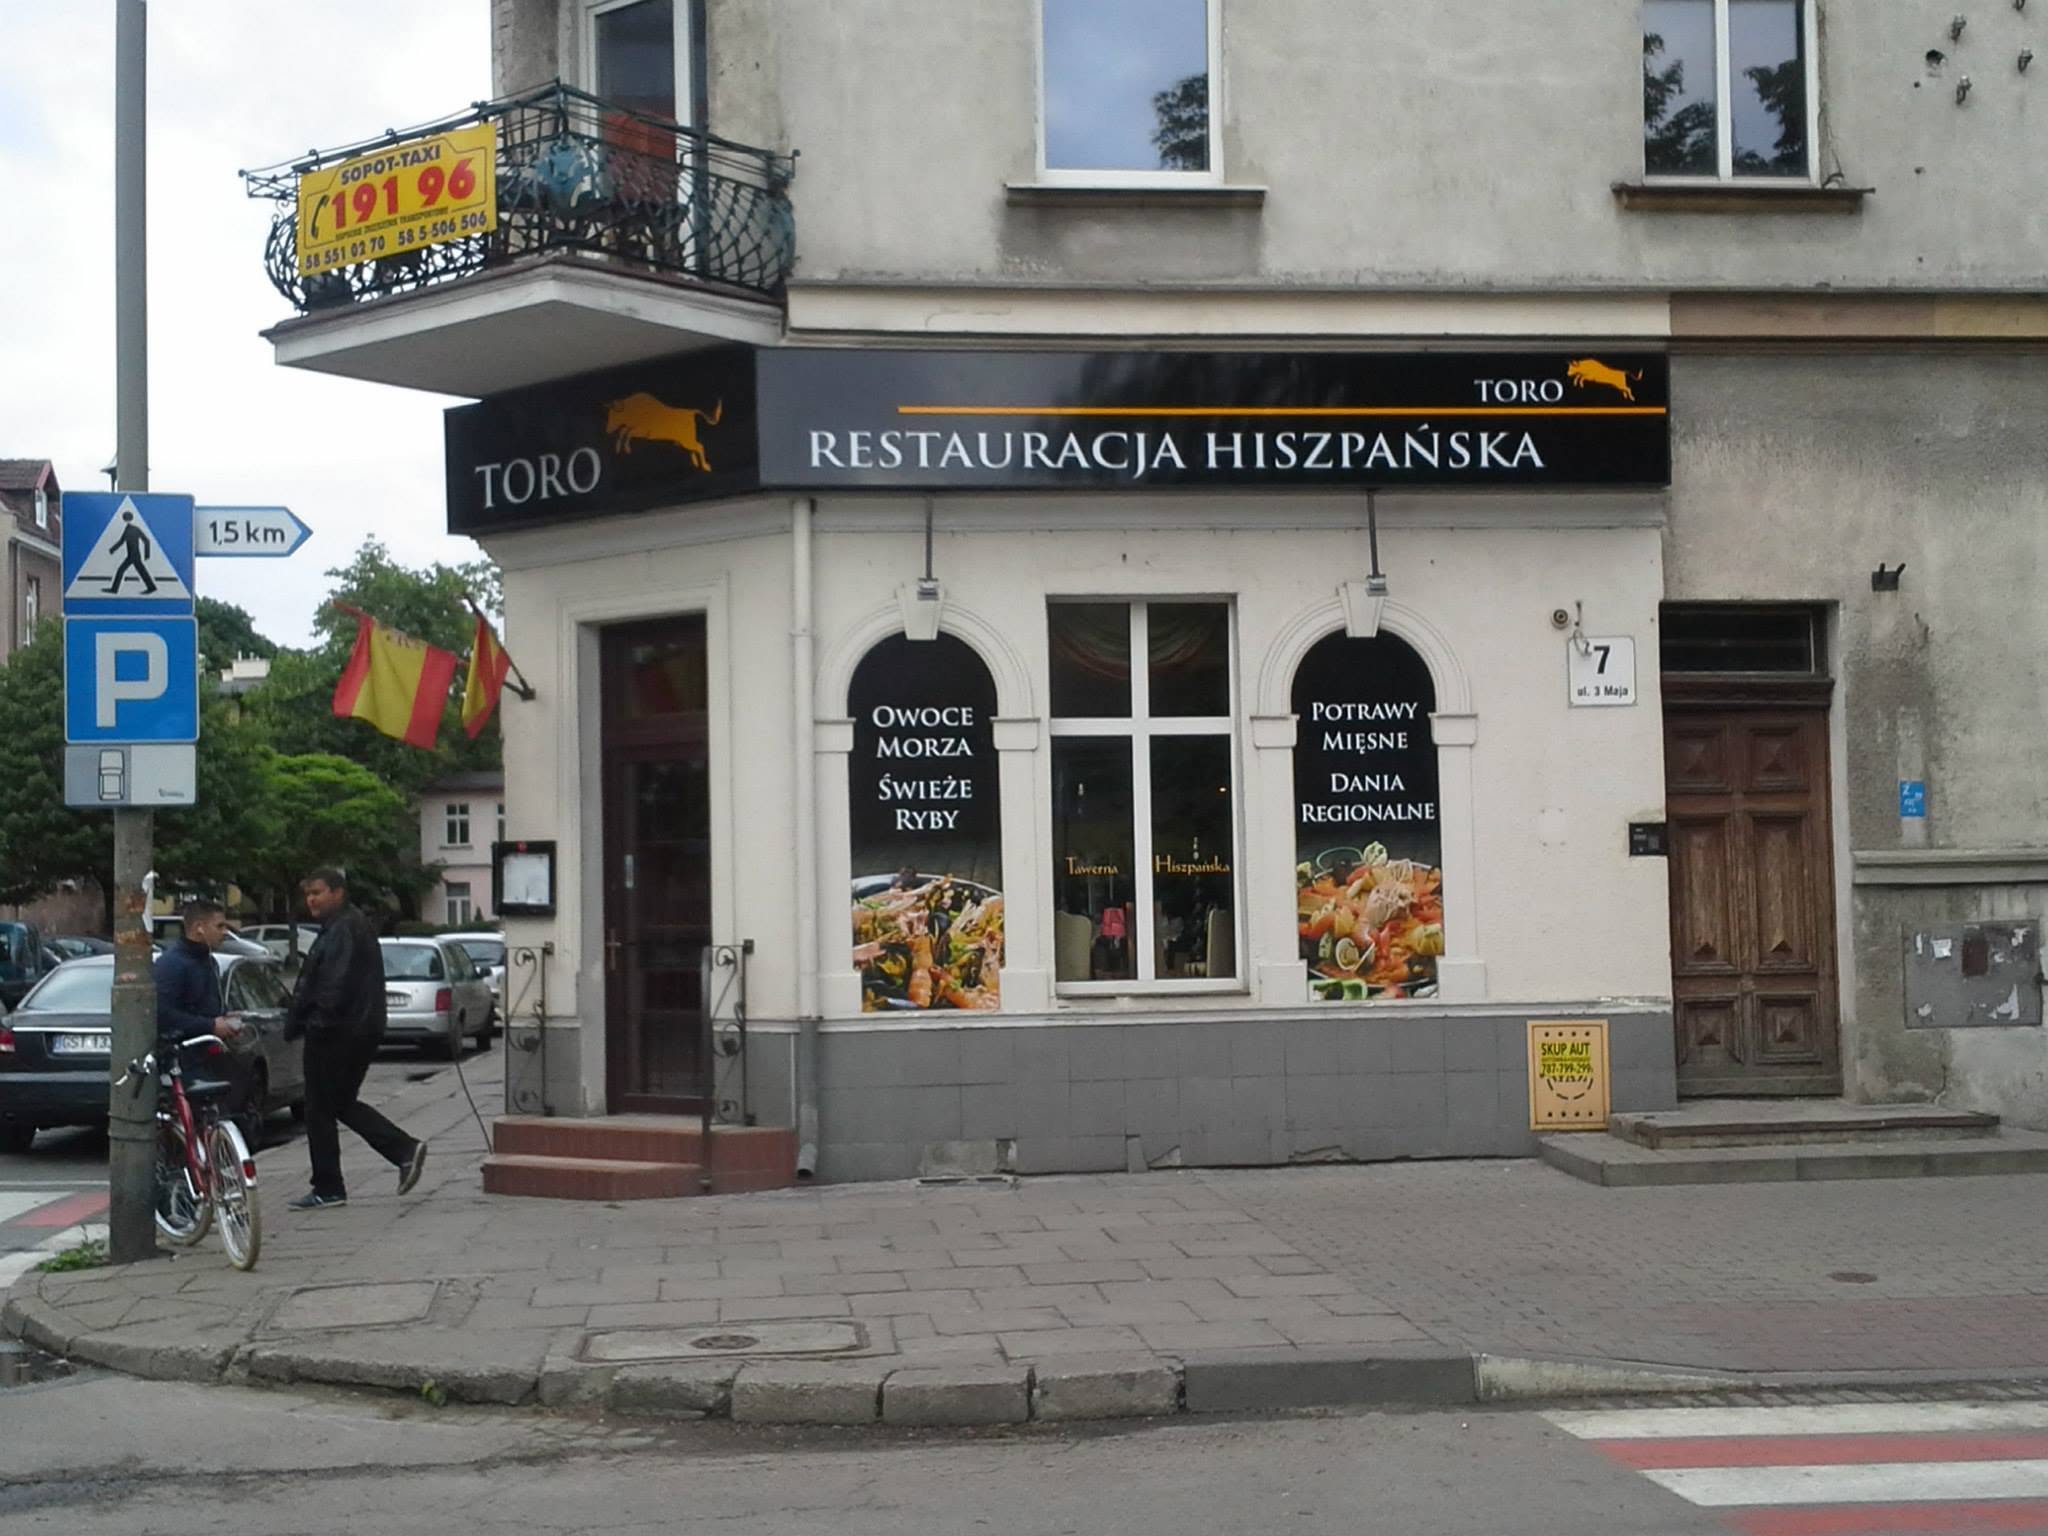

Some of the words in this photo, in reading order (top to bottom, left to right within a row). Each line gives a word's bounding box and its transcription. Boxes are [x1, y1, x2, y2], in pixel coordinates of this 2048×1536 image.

[341, 144, 441, 186] SOPOT-TAXI
[331, 175, 398, 230] 191
[417, 156, 476, 208] 96
[305, 253, 320, 270] 58
[324, 246, 346, 265] 551
[370, 235, 385, 252] 70
[461, 210, 487, 231] 506
[1474, 380, 1564, 402] TORO
[810, 430, 1186, 478] RESTAURACJA
[1207, 423, 1544, 472] HISZPAŃSKA
[475, 448, 601, 508] TORO
[209, 520, 239, 546] 1,5
[246, 520, 285, 543] km
[1594, 645, 1610, 674] 7
[95, 632, 168, 727] P
[1594, 685, 1601, 697] 3
[1604, 685, 1629, 699] Maja
[872, 705, 974, 728] OWOCE
[1312, 702, 1418, 721] POTRAWY
[876, 736, 973, 758] MORZA
[1322, 731, 1408, 755] MIĘSNE
[878, 772, 973, 801] ŚWIEŻE
[1331, 773, 1405, 793] DANIA
[895, 808, 960, 831] RYBY
[1302, 802, 1435, 823] REGIONALNE
[1065, 856, 1118, 875] Tawerna
[1541, 1042, 1568, 1056] SKUP
[1569, 1042, 1590, 1056] AUT
